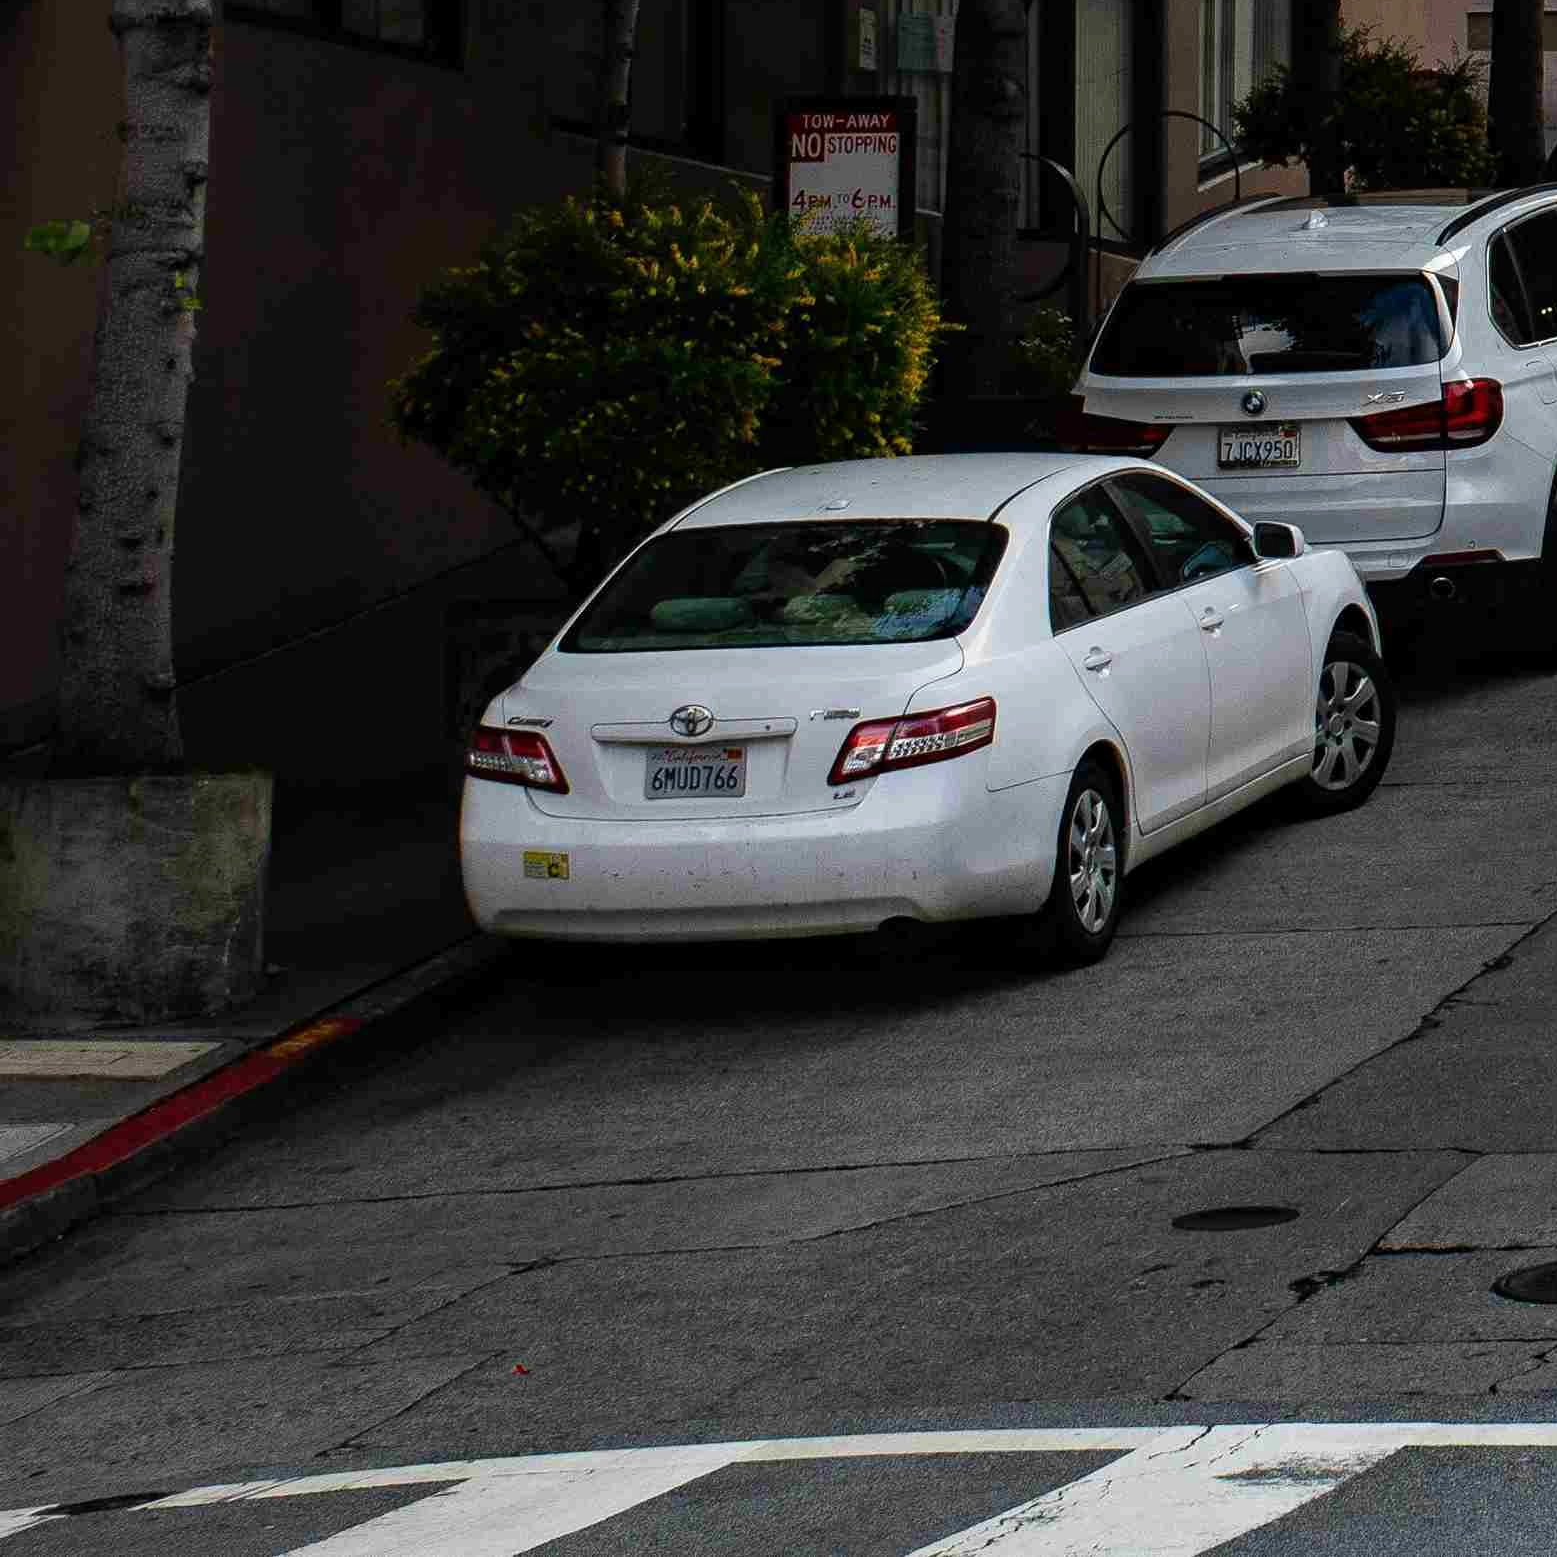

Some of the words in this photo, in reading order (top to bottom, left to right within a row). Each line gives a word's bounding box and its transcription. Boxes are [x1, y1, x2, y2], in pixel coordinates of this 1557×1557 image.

[802, 114, 890, 129] TOW-AWAY
[791, 131, 822, 158] NO
[827, 135, 897, 155] STOPPING
[1223, 441, 1293, 460] 7JCX950
[651, 764, 739, 792] 6MUD766
